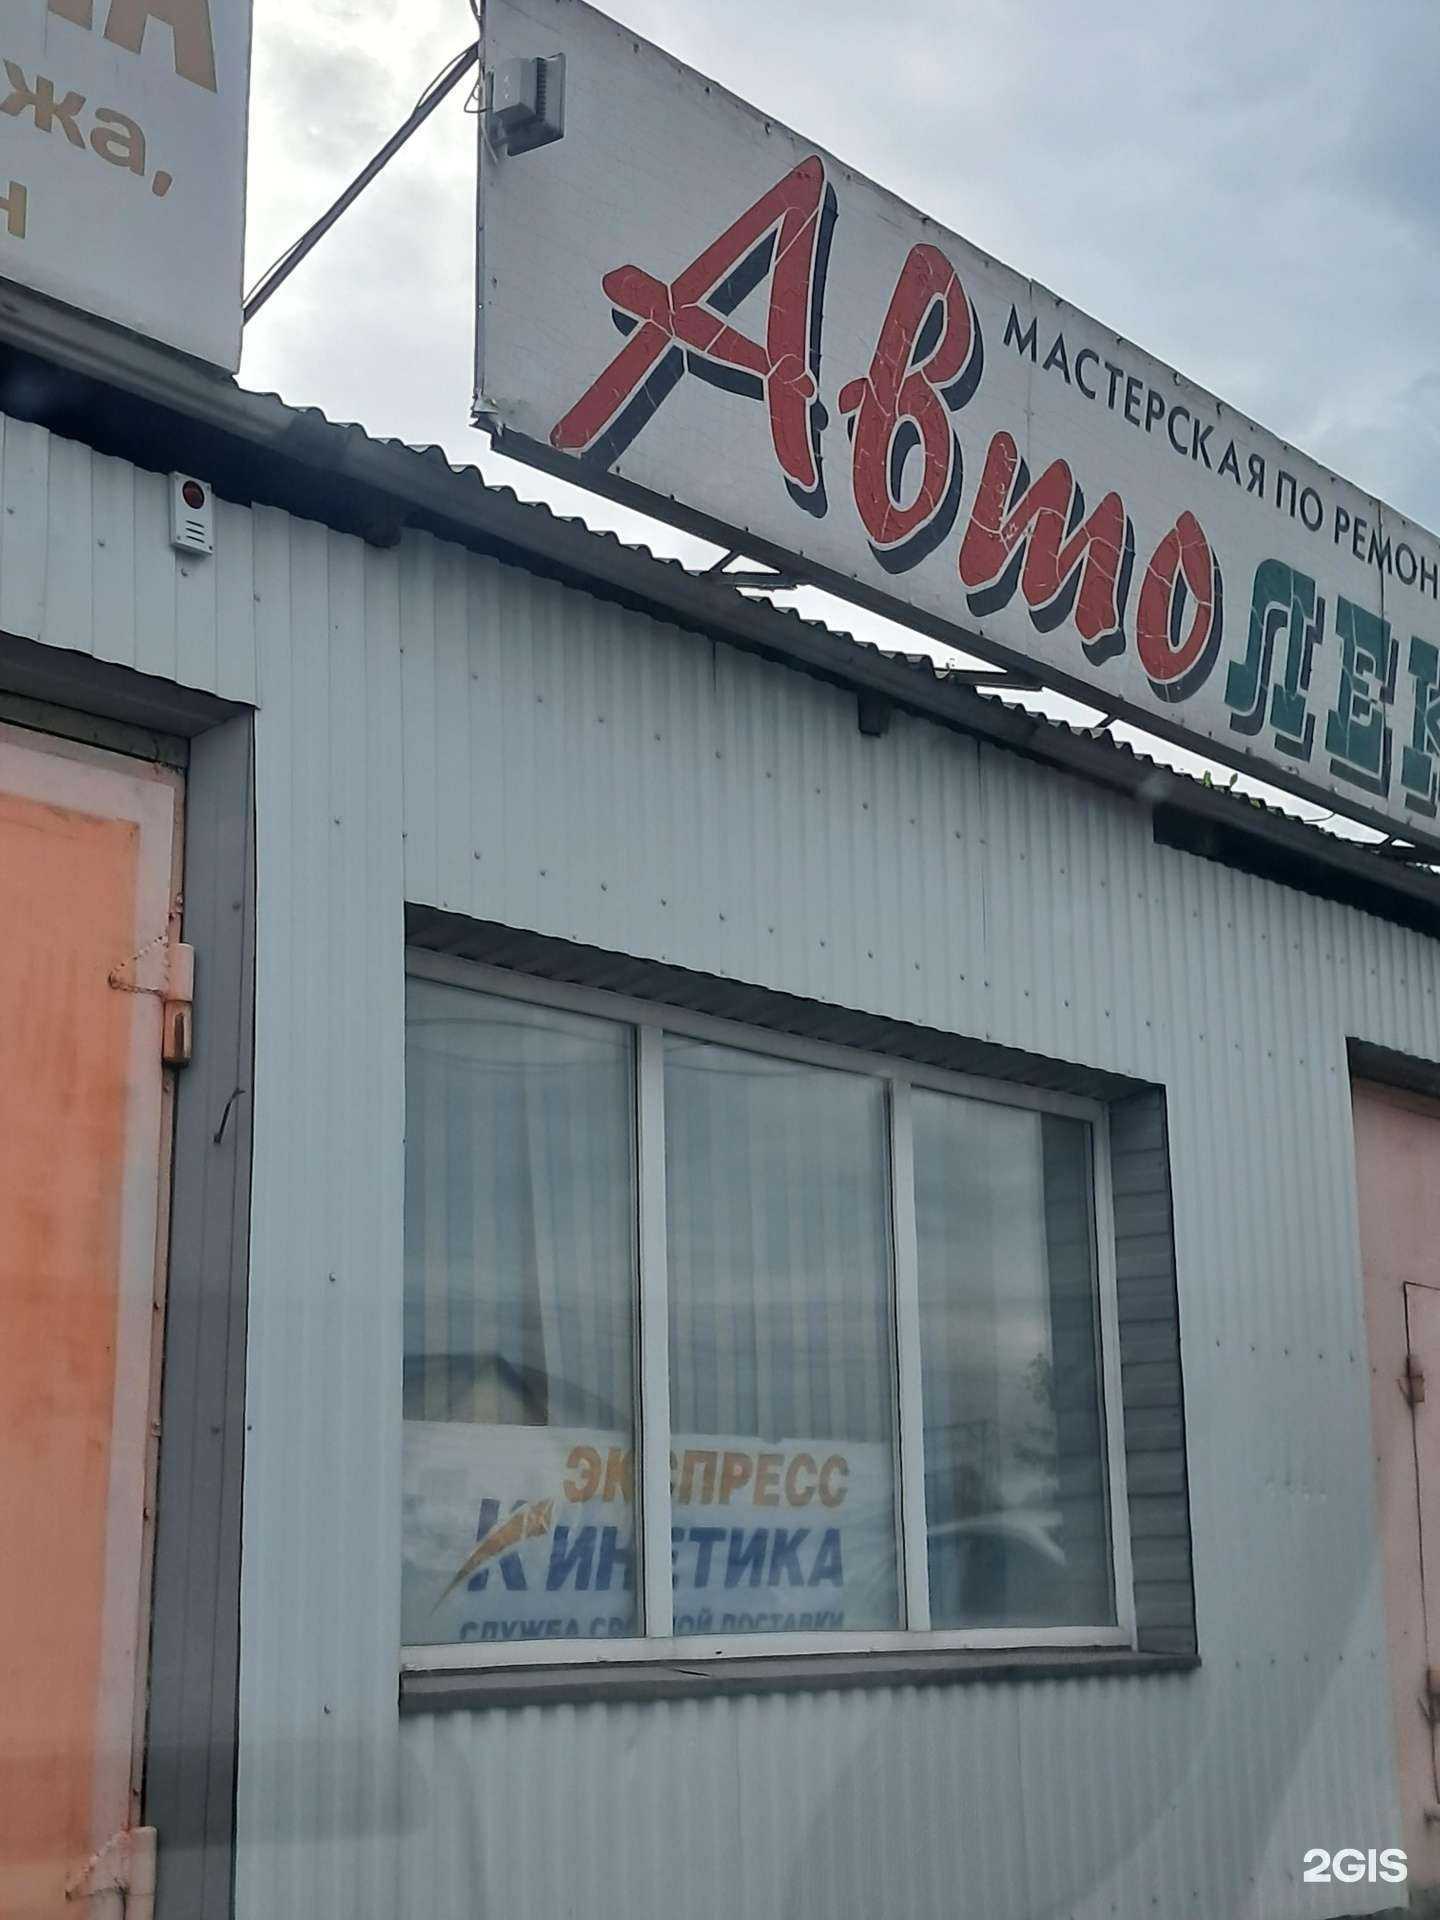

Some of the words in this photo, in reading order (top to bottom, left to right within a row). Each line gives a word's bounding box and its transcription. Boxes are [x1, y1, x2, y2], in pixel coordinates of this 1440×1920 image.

[1002, 303, 1265, 499] МАСТЕРСКАЯ
[1275, 468, 1324, 532] ПО
[1334, 504, 1438, 600] РЕМОН
[564, 1445, 848, 1508] ЭКПРЕСС
[467, 1498, 845, 1592] КИНТИКА
